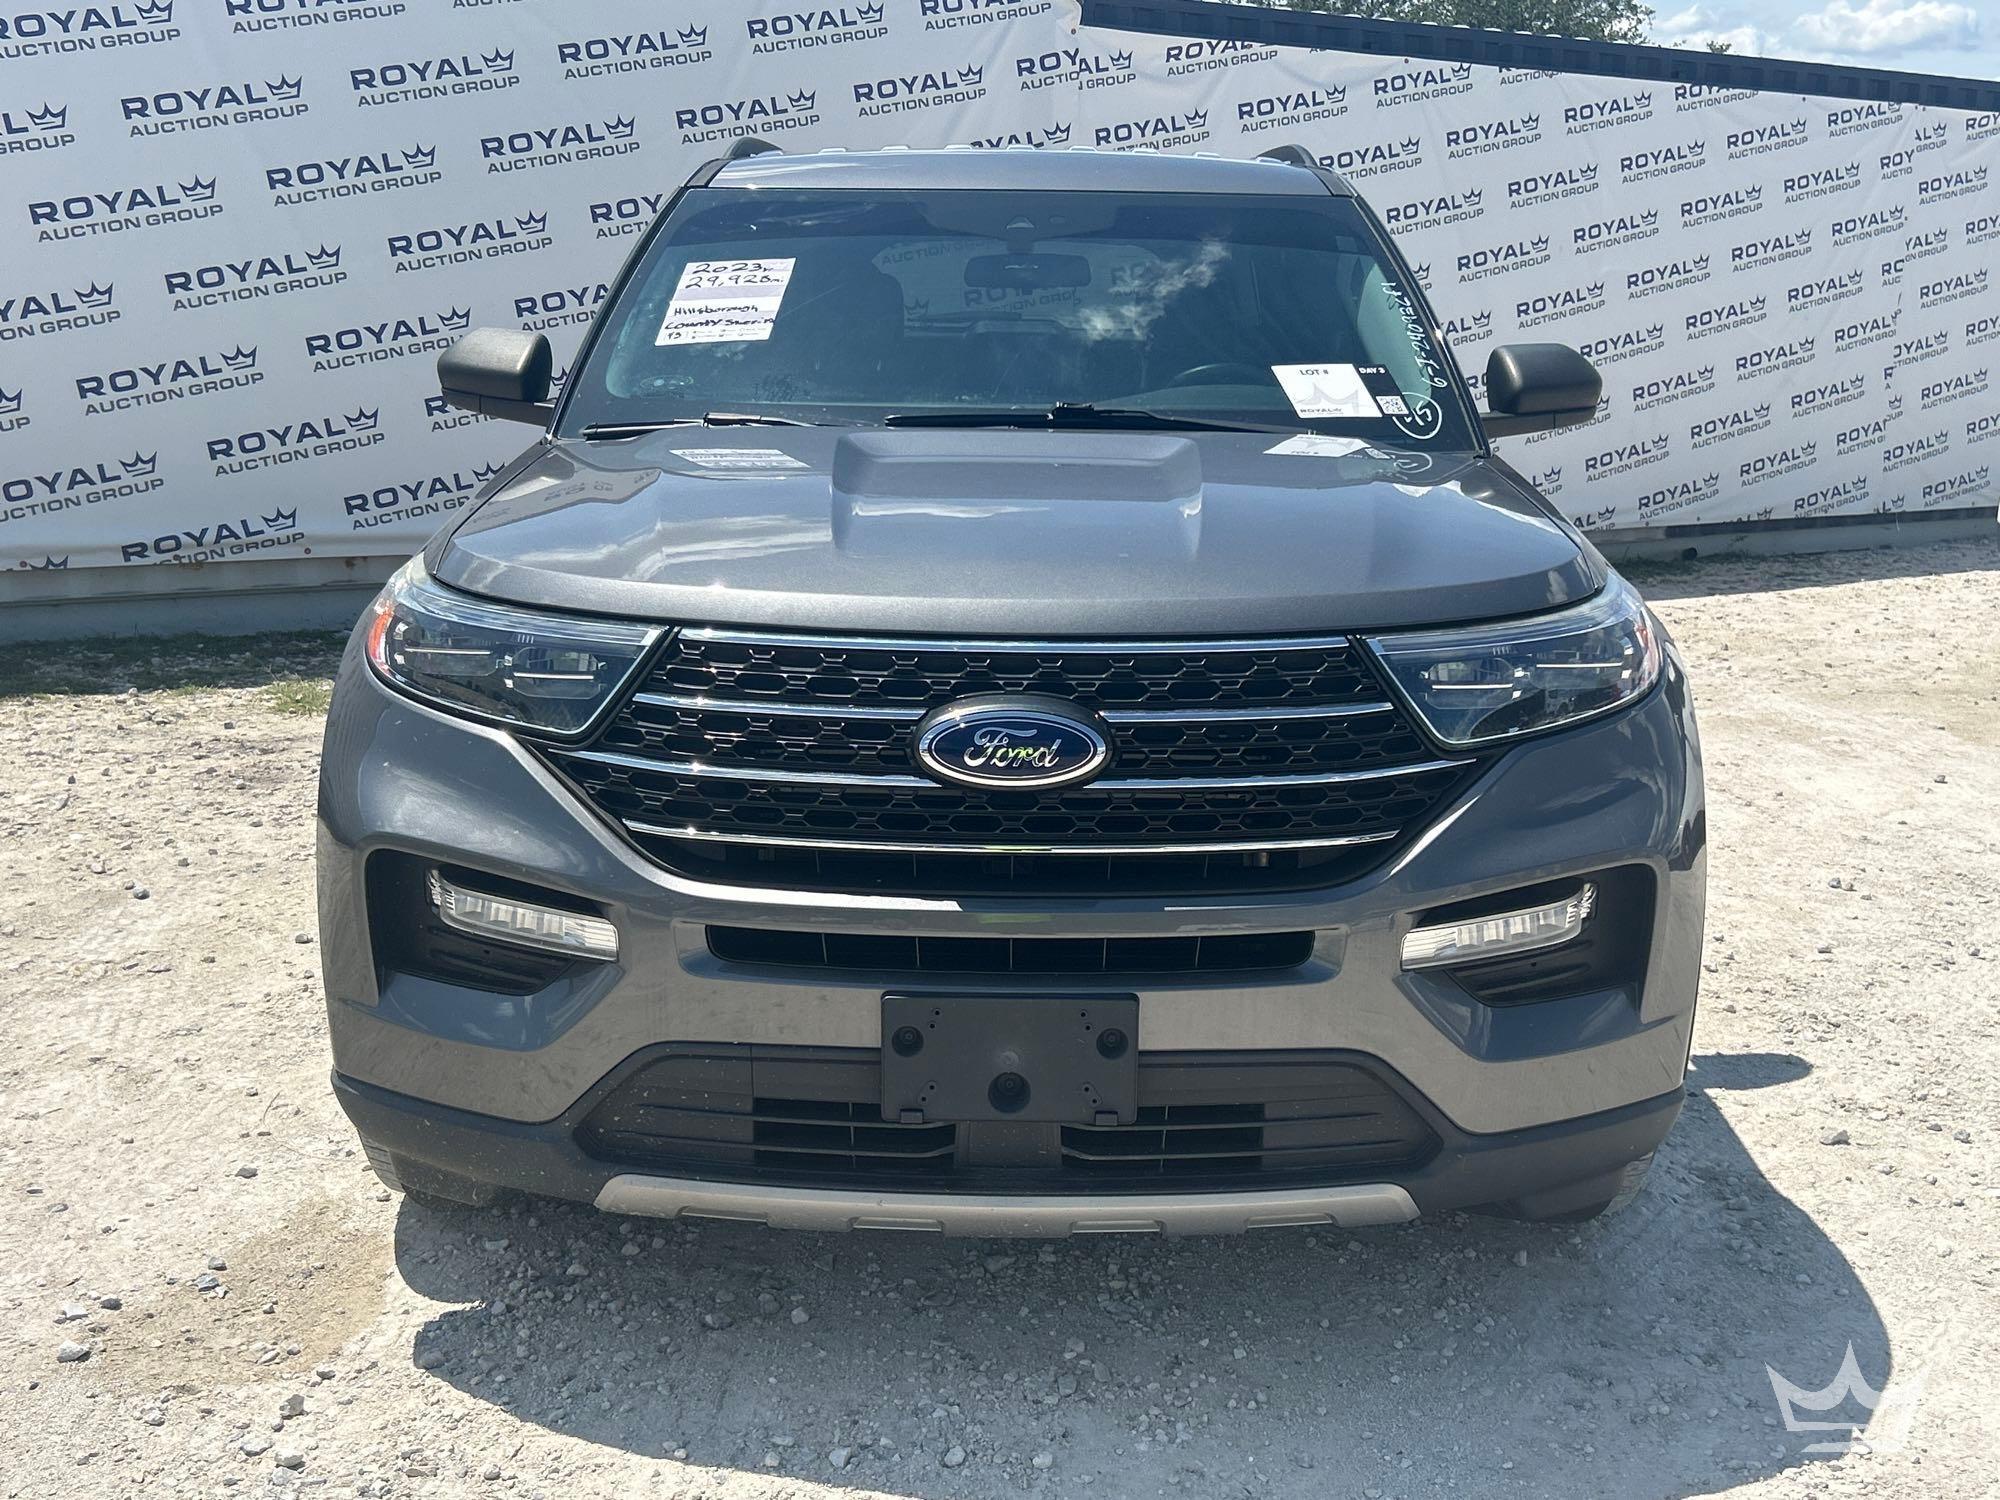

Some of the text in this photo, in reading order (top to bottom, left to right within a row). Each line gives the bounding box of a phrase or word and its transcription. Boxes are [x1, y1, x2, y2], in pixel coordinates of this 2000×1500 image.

[233, 4, 406, 34] AUCTION GROUP
[746, 8, 858, 39] ROYAL
[0, 28, 181, 59] UCTION GROUP
[557, 31, 679, 64] ROYAL
[752, 26, 889, 55] AUCTION GROUP
[349, 55, 484, 91] ROYAL
[564, 50, 713, 80] AUCTION GROUP
[358, 75, 520, 108] AUCTION GROUP
[853, 71, 958, 103] ROYAL
[1373, 68, 1452, 96] ROYAL
[1376, 82, 1474, 109] AUCTION GROUP
[120, 83, 268, 121] ROYAL
[675, 96, 789, 130] ROYAL
[858, 87, 987, 118] AUCTION GROUP
[1237, 90, 1325, 121] ROYAL
[1564, 97, 1634, 124] ROYAL
[1827, 103, 1887, 128] ROYAL
[129, 103, 309, 138] AUCTION GROUP
[681, 114, 821, 145] AUCTION GROUP
[1094, 115, 1186, 147] ROYAL
[1240, 105, 1349, 134] AUCTION GROUP
[1446, 119, 1522, 148] ROYAL
[1566, 110, 1653, 136] AUCTION GROUP
[1828, 114, 1903, 139] AUCTION GROUP
[480, 123, 606, 159] ROYAL
[1162, 130, 1210, 149] GROUP
[1447, 132, 1542, 160] AUCTION GROUP
[1726, 123, 1791, 150] ROYAL
[1728, 135, 1809, 161] AUCTION GROUP
[265, 152, 404, 191] ROYAL
[487, 140, 641, 175] AUCTION GROUP
[1620, 145, 1688, 173] ROYAL
[1621, 158, 1706, 185] AUCTION GROUP
[273, 171, 442, 207] AUCTION GROUP
[1507, 169, 1580, 198] ROYAL
[1783, 167, 1845, 194] ROYAL
[1784, 178, 1861, 205] AUCTION GROUP
[1918, 171, 1974, 195] ROYAL
[1919, 181, 1988, 206] AUCTION GROUP
[28, 185, 181, 225] ROYAL
[1385, 194, 1463, 225] ROYAL
[1509, 182, 1599, 210] AUCTION GROUP
[1680, 190, 1746, 218] ROYAL
[38, 204, 224, 243] AUCTION GROUP
[1388, 207, 1485, 237] AUCTION GROUP
[1573, 215, 1641, 244] ROYAL
[1681, 202, 1763, 230] AUCTION GROUP
[1831, 210, 1889, 237] ROYAL
[387, 219, 518, 258] ROYAL
[1574, 227, 1660, 256] AUCTION GROUP
[1731, 234, 1795, 263] ROYAL
[1832, 221, 1904, 248] AUCTION GROUP
[394, 236, 553, 274] AUCTION GROUP
[1457, 241, 1531, 272] ROYAL
[1458, 253, 1551, 284] AUCTION GROUP
[1732, 246, 1812, 273] AUCTION GROUP
[164, 254, 308, 295] ROYAL
[1626, 260, 1693, 290] ROYAL
[1627, 271, 1711, 301] AUCTION GROUP
[1787, 275, 1849, 303] ROYAL
[173, 271, 348, 312] AUCTION GROUP
[1516, 288, 1587, 318] ROYAL
[1788, 286, 1864, 314] AUCTION GROUP
[1517, 299, 1606, 330] AUCTION GROUP
[1685, 302, 1750, 331] ROYAL
[1686, 312, 1767, 342] AUCTION GROUP
[305, 316, 440, 357] ROYAL
[1579, 330, 1647, 358] ROYAL
[1628, 340, 1665, 358] GROUP
[313, 340, 408, 373] AUCTION
[1735, 343, 1799, 372] ROYAL
[1736, 352, 1816, 383] AUCTION GROUP
[75, 355, 223, 400] ROYAL
[1632, 372, 1698, 402] ROYAL
[85, 371, 264, 417] AUCTION GROUP
[1633, 381, 1716, 414] AUCTION GROUP
[1790, 380, 1850, 409] ROYAL
[1792, 389, 1866, 420] AUCTION GROUP
[206, 417, 347, 461] ROYAL
[1690, 410, 1754, 440] ROYAL
[1691, 419, 1771, 451] AUCTION GROUP
[215, 432, 385, 477] AUCTION GROUP
[1585, 441, 1652, 473] ROYAL
[1585, 450, 1670, 484] AUCTION GROUP
[1739, 448, 1801, 478] ROYAL
[1741, 456, 1817, 488] AUCTION GROUP
[343, 473, 475, 517] ROYAL
[1637, 479, 1703, 511] ROYAL
[1639, 488, 1720, 522] AUCTION GROUP
[352, 500, 440, 530] AUCTION
[120, 518, 266, 563] ROYAL
[230, 531, 305, 556] GROUP
[963, 726, 1062, 767] Ford
